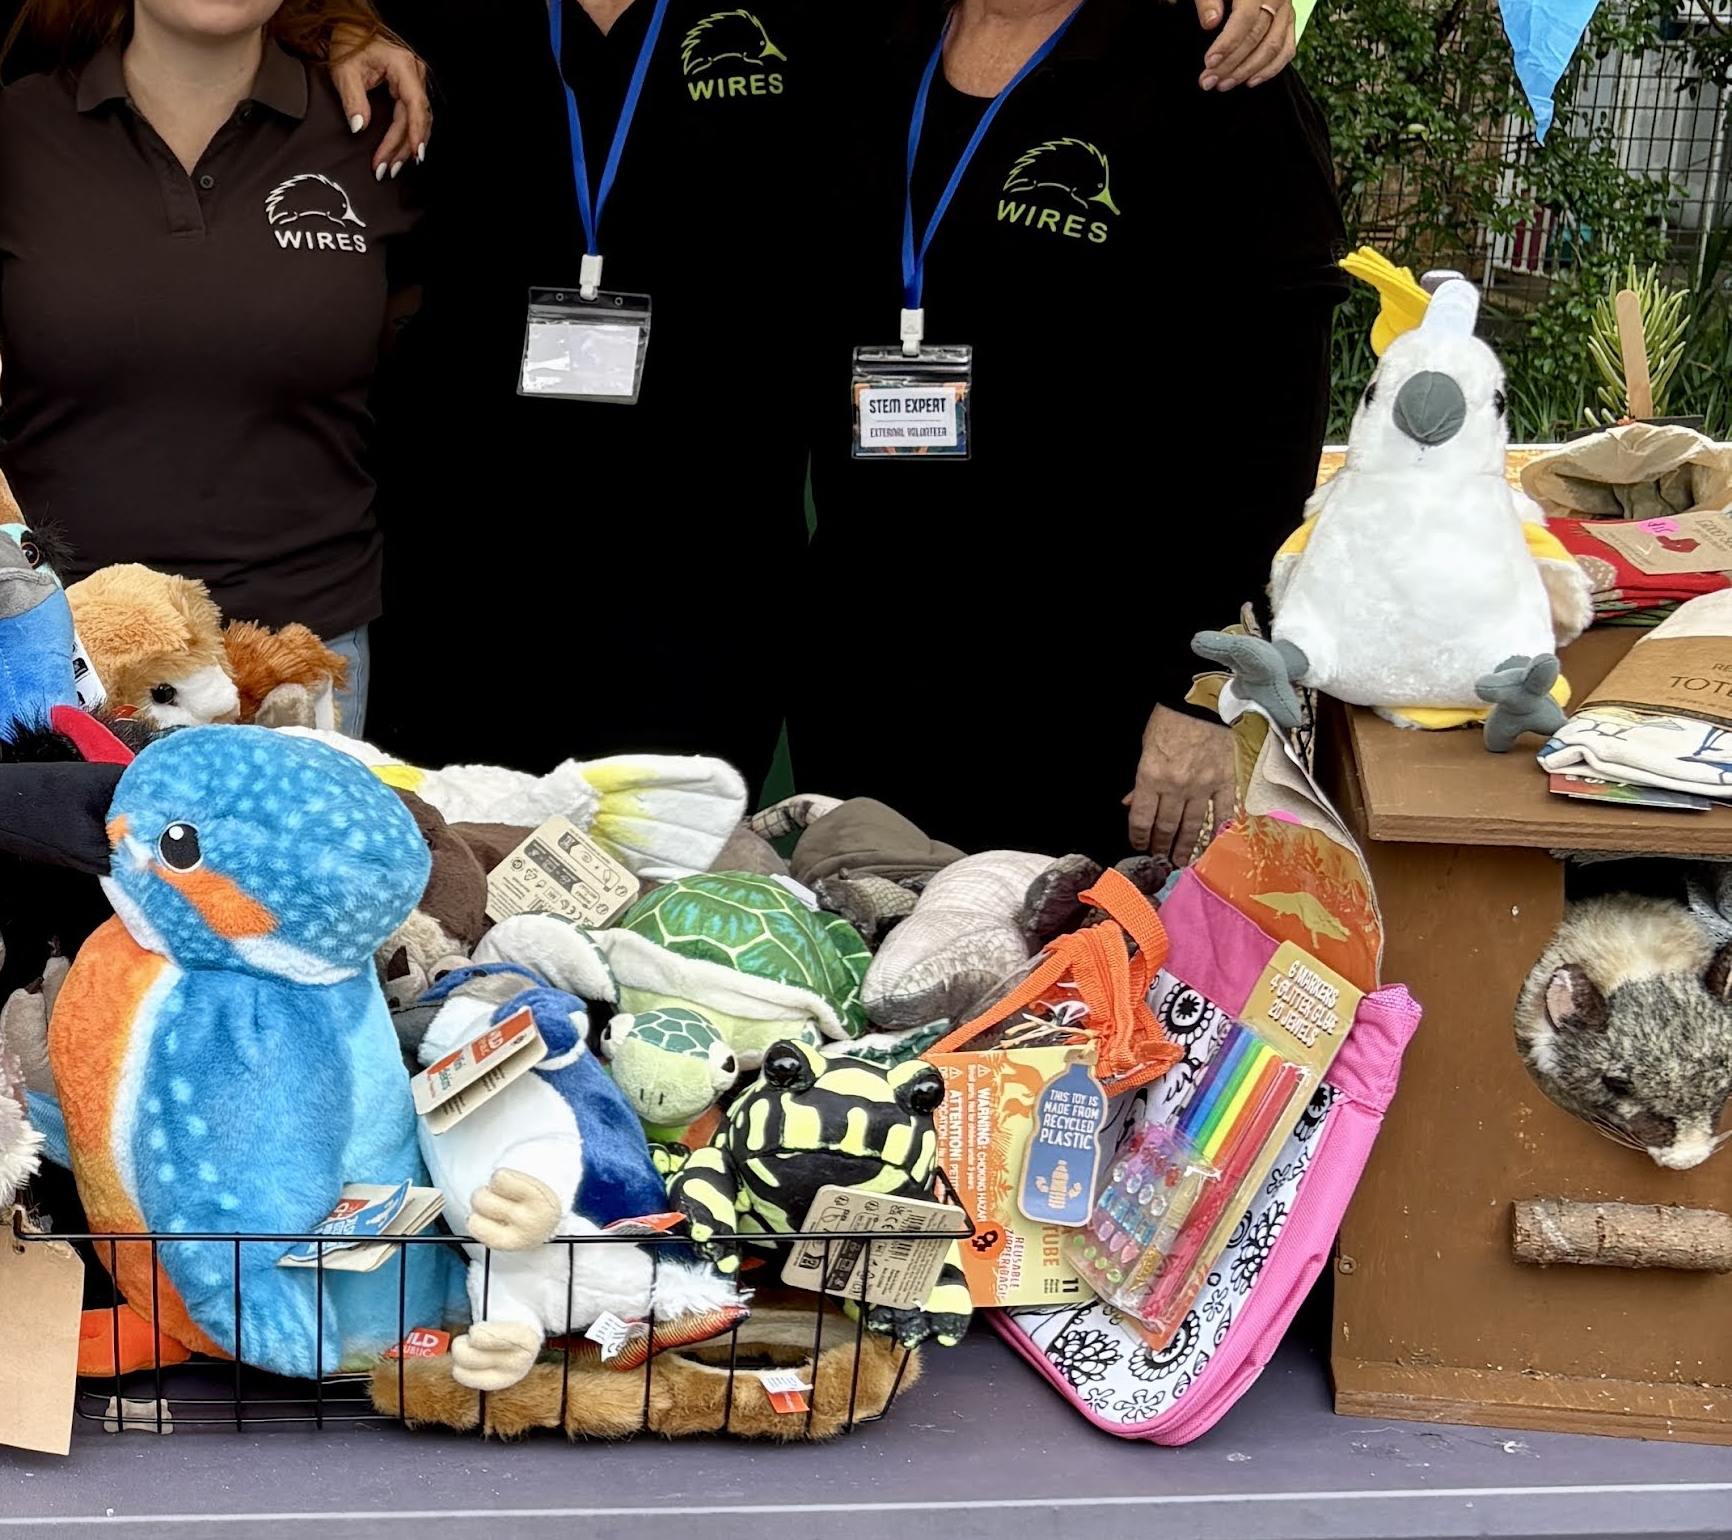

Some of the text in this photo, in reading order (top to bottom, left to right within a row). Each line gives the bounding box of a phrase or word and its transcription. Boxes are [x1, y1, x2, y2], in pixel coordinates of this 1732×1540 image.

[687, 73, 784, 102] WIRES
[997, 199, 1108, 244] WIRES
[274, 230, 367, 253] WIRES
[869, 397, 946, 414] STEM EXPERT
[1276, 979, 1314, 1019] GLITTER
[1296, 965, 1339, 1009] MARKERS
[1268, 999, 1319, 1048] 20 JEWELS
[1050, 1089, 1099, 1106] THIS TOY IS
[977, 1087, 990, 1151] WARNING:
[1043, 1102, 1100, 1120] MADE FROM
[1043, 1114, 1095, 1134] RECYCLED
[949, 1090, 962, 1162] ATTENTION!
[1039, 1129, 1093, 1150] PLASTIC
[1010, 1236, 1025, 1289] REUSABLE
[1062, 1278, 1079, 1295] 11
[405, 1331, 439, 1348] ILD
